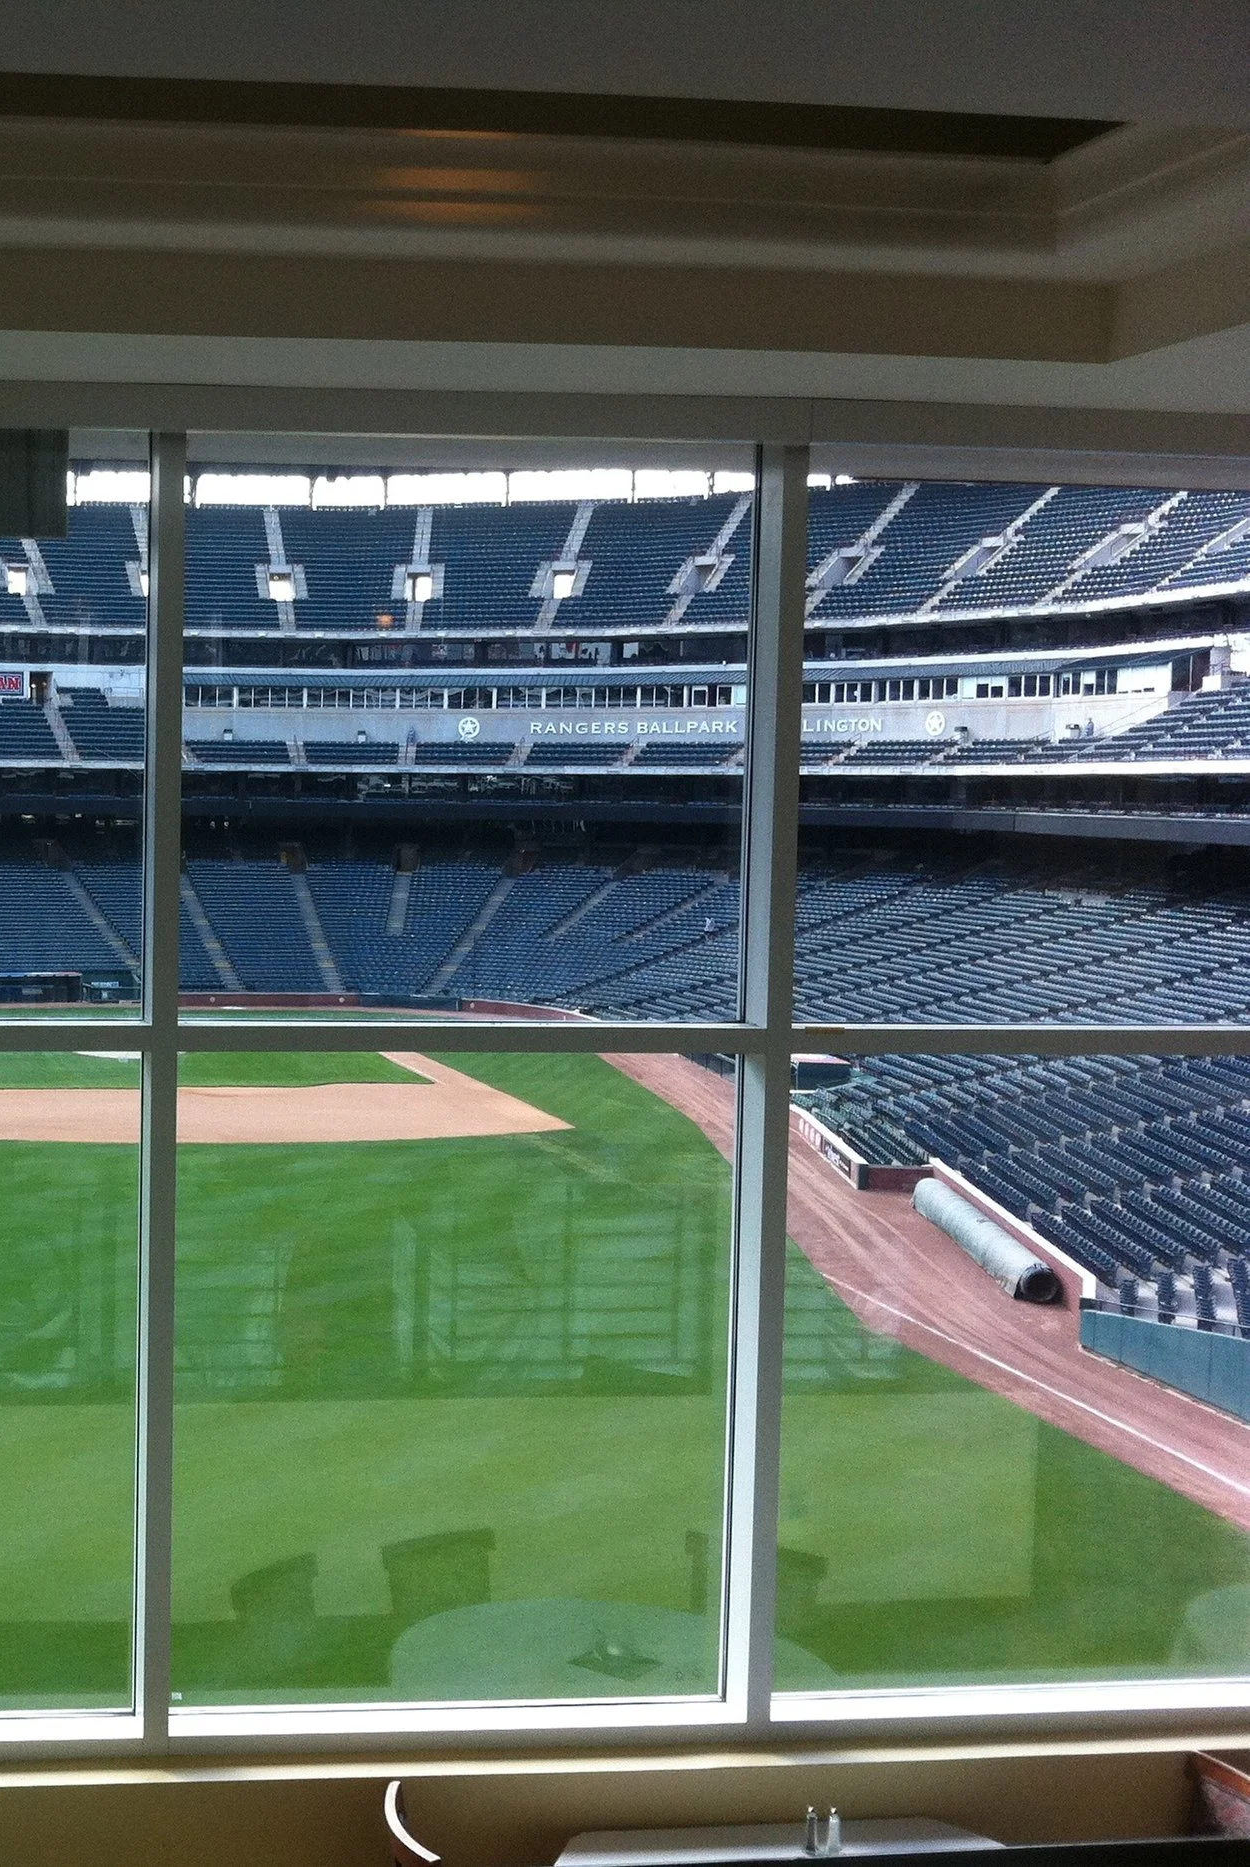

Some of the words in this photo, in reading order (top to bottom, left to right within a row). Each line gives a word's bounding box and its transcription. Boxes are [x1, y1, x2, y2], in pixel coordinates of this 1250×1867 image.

[530, 722, 630, 735] RANGERS
[637, 720, 738, 734] BALLPARK
[802, 718, 883, 732] LINGTON
